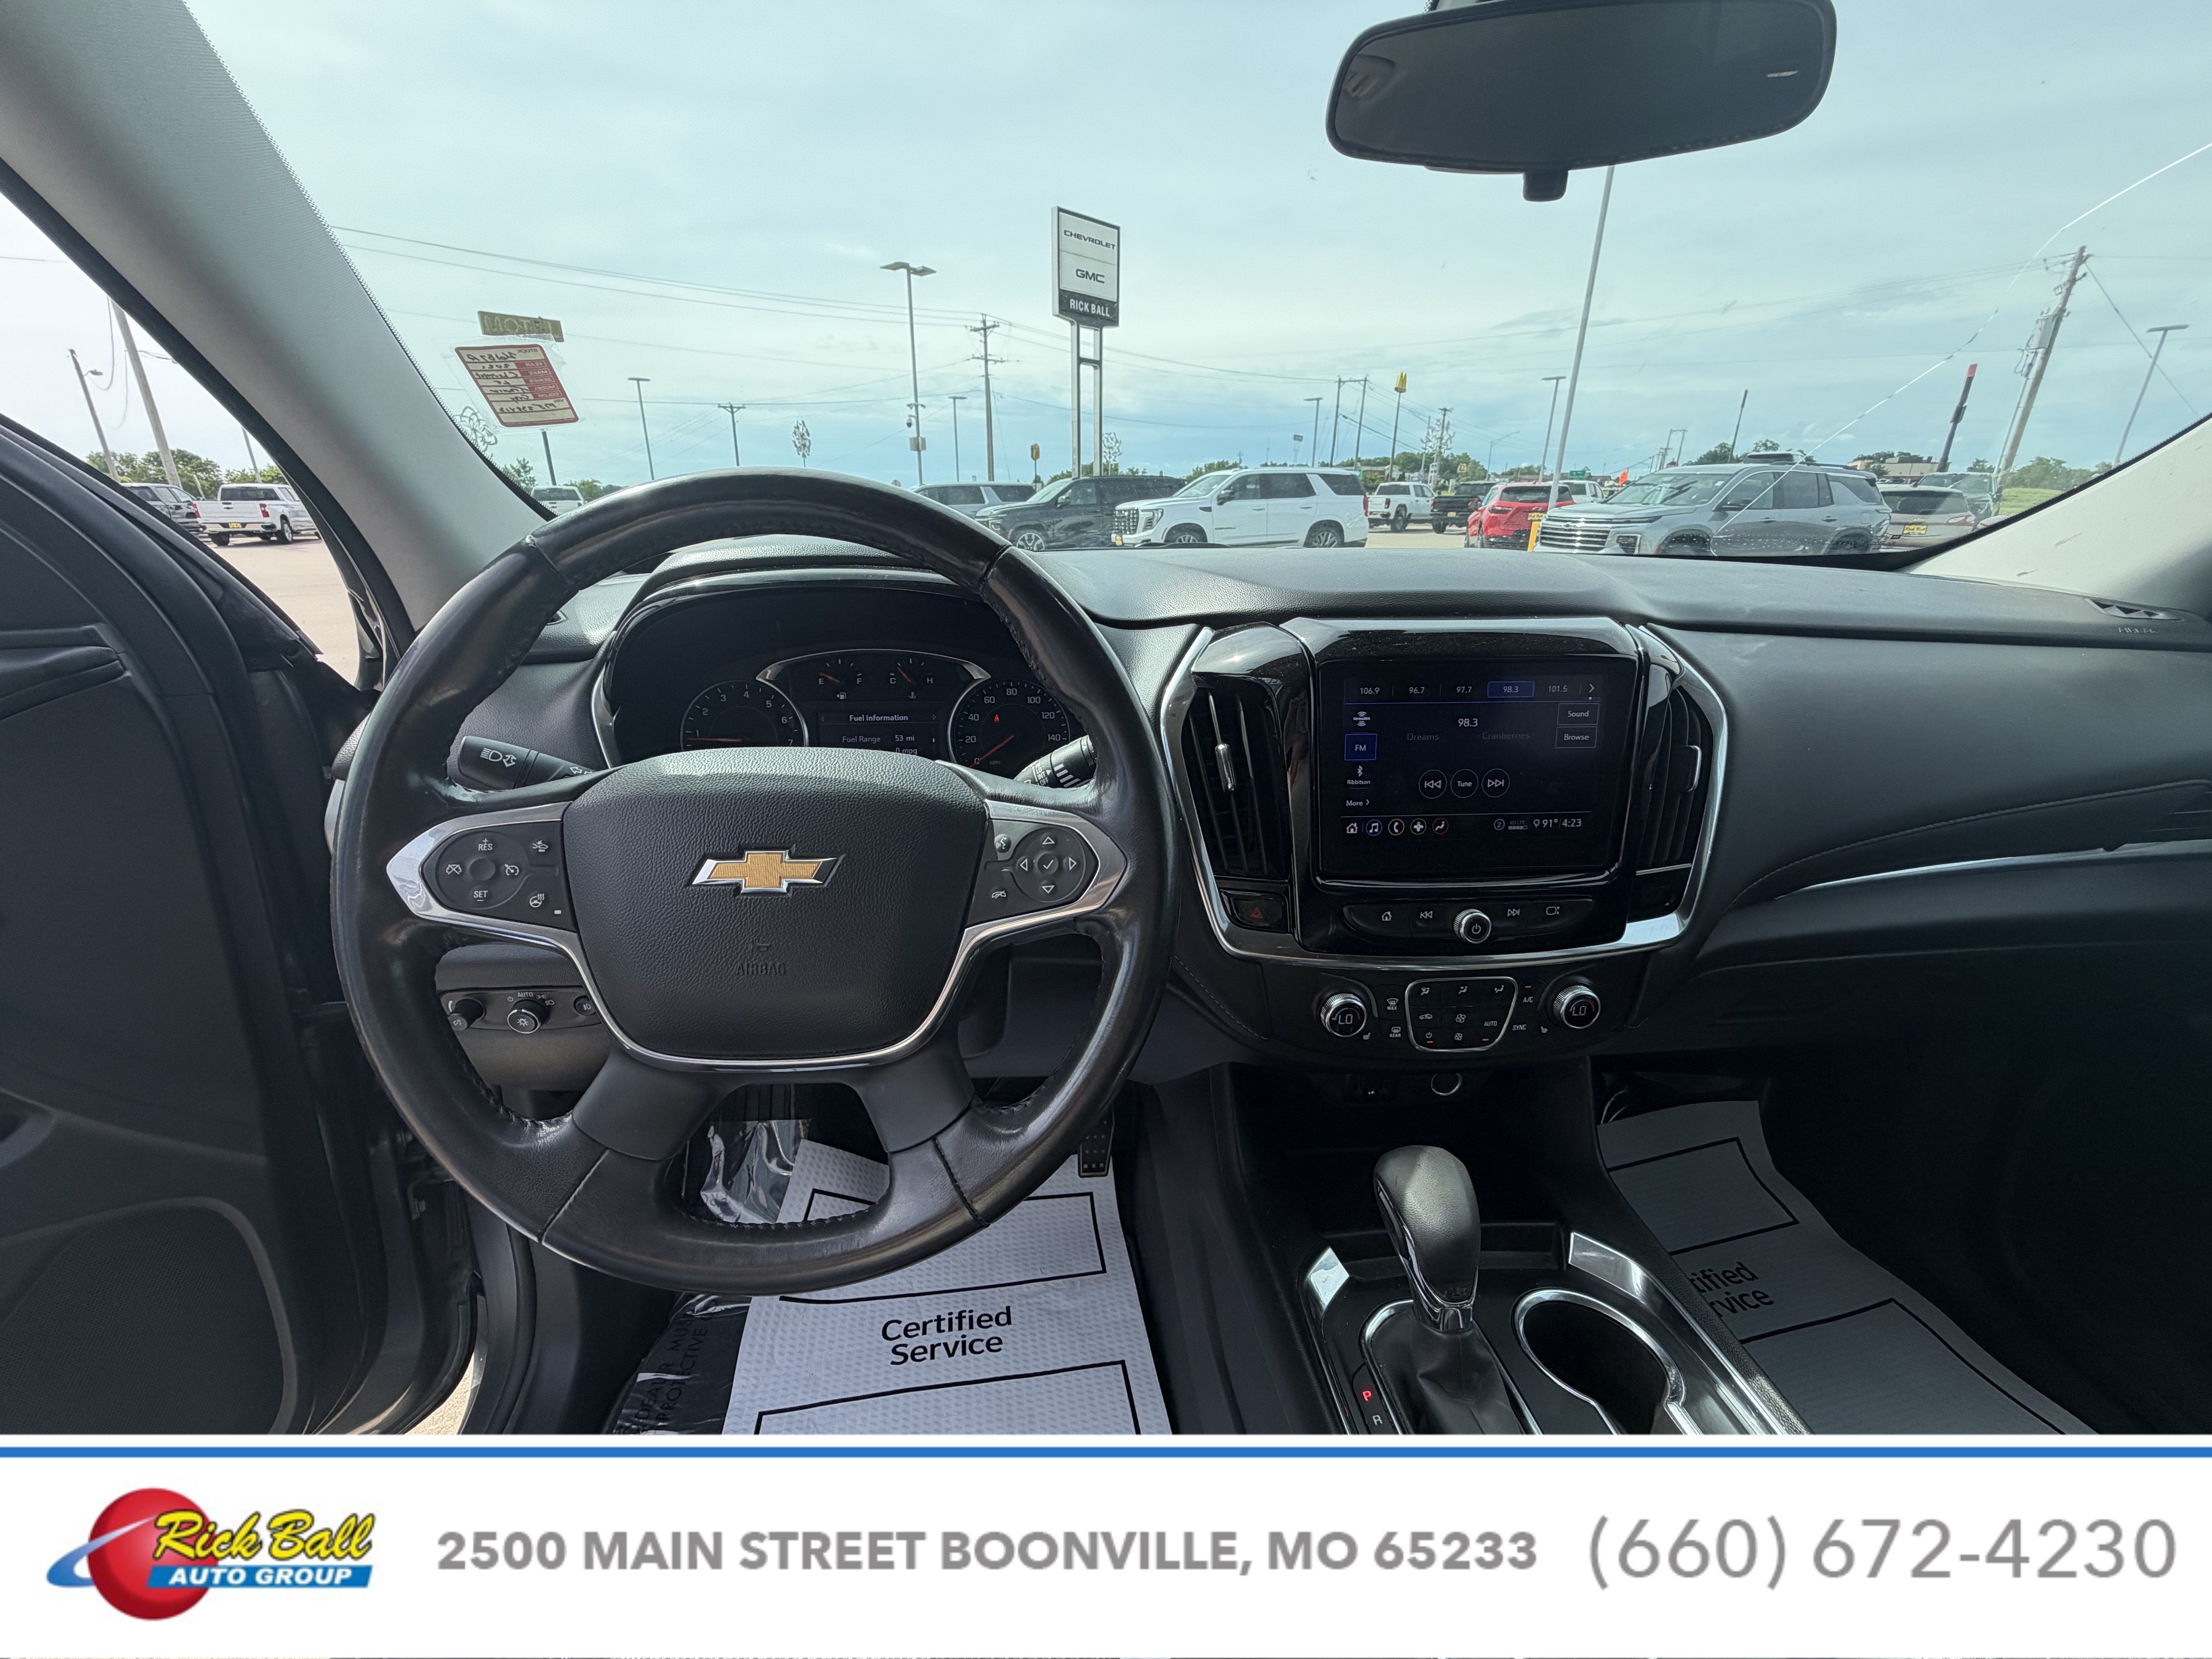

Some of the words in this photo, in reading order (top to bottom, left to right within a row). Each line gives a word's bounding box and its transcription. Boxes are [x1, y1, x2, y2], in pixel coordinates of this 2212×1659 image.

[1064, 230, 1116, 250] CHEVROLET
[1076, 268, 1105, 284] GMC
[1070, 299, 1090, 313] RICK
[1091, 304, 1110, 317] BALL
[702, 708, 709, 716] 2
[1458, 718, 1478, 727] 98.3
[965, 735, 976, 744] 20
[1482, 732, 1530, 740] Cranberries
[1037, 771, 1046, 780] INT
[1040, 777, 1049, 786] OFF
[1561, 818, 1582, 827] 4:23
[473, 890, 489, 898] SET
[1572, 1006, 1587, 1016] LO
[1338, 1014, 1353, 1025] LO
[882, 1305, 1012, 1341] Certified
[890, 1334, 1003, 1365] Service
[1362, 1389, 1373, 1402] P
[1372, 1415, 1383, 1425] R
